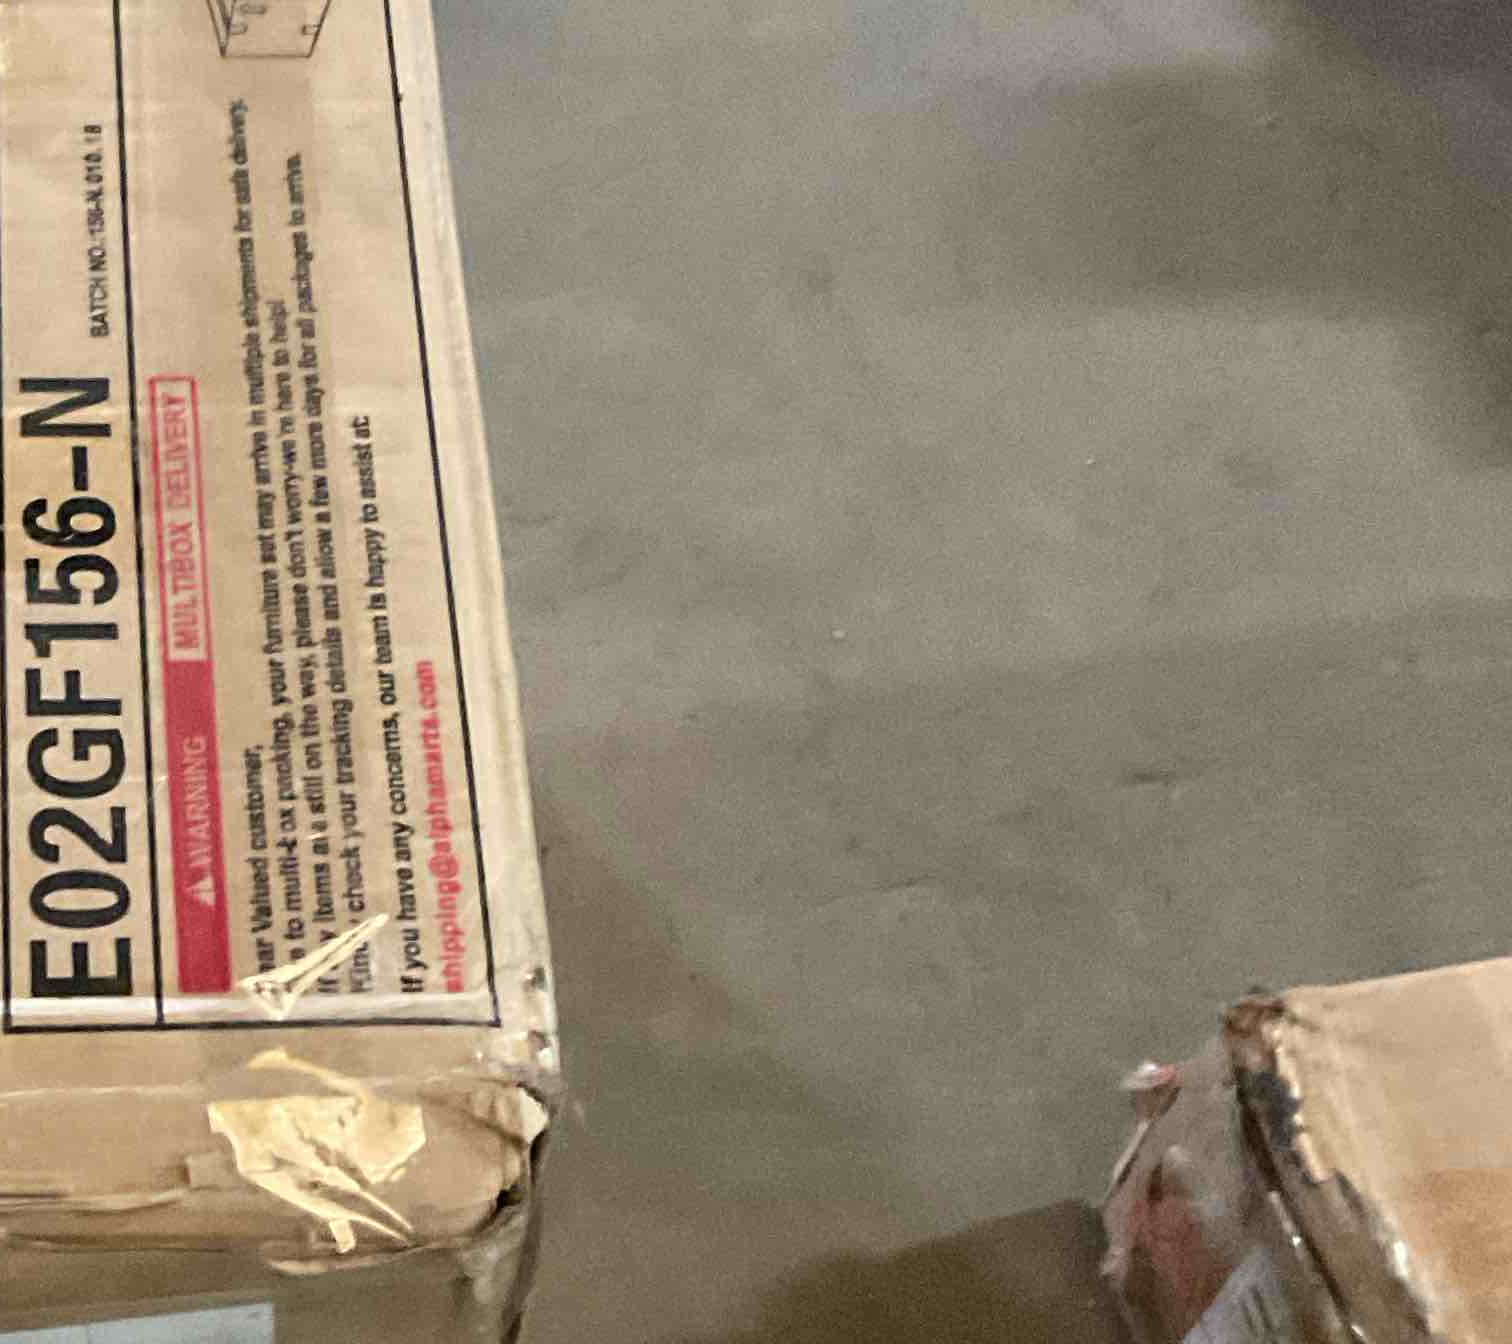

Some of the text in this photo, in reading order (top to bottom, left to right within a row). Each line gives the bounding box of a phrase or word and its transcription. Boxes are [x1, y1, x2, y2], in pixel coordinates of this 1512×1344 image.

[233, 207, 252, 231] for
[288, 209, 304, 225] to
[238, 237, 259, 326] shipments
[292, 231, 317, 312] packages
[87, 276, 109, 336] BATCH
[295, 317, 315, 338] all
[242, 332, 264, 405] multiple
[272, 349, 289, 366] to
[298, 344, 317, 367] for
[273, 372, 294, 411] here
[302, 373, 324, 416] days
[245, 410, 265, 425] in
[251, 430, 271, 484] arrive
[309, 421, 327, 469] more
[308, 475, 329, 506] few
[352, 443, 376, 497] assist
[161, 393, 199, 649] MULTIBOX DELIVERY
[256, 489, 275, 528] may
[315, 510, 331, 522] a
[357, 503, 378, 522] to
[257, 534, 276, 562] set
[314, 528, 336, 578] allow
[364, 527, 386, 586] happy
[260, 569, 283, 653] furniture
[291, 582, 318, 647] please
[316, 583, 339, 620] and
[366, 592, 387, 609] is
[322, 626, 346, 692] details
[371, 615, 393, 663] team
[19, 376, 133, 996] E02GF156-N
[269, 658, 291, 705] your
[377, 669, 397, 705] our
[299, 703, 319, 737] the
[330, 698, 354, 783] tracking
[304, 742, 322, 769] on
[381, 711, 406, 814] concerns,
[182, 734, 214, 865] WARNING
[244, 744, 267, 849] customer,
[303, 775, 326, 813] still
[339, 790, 363, 838] your
[391, 820, 415, 861] any
[246, 857, 271, 932] Valued
[340, 846, 365, 911] check
[395, 867, 417, 919] have
[285, 917, 303, 939] to
[402, 928, 428, 969] you
[401, 975, 423, 992] If
